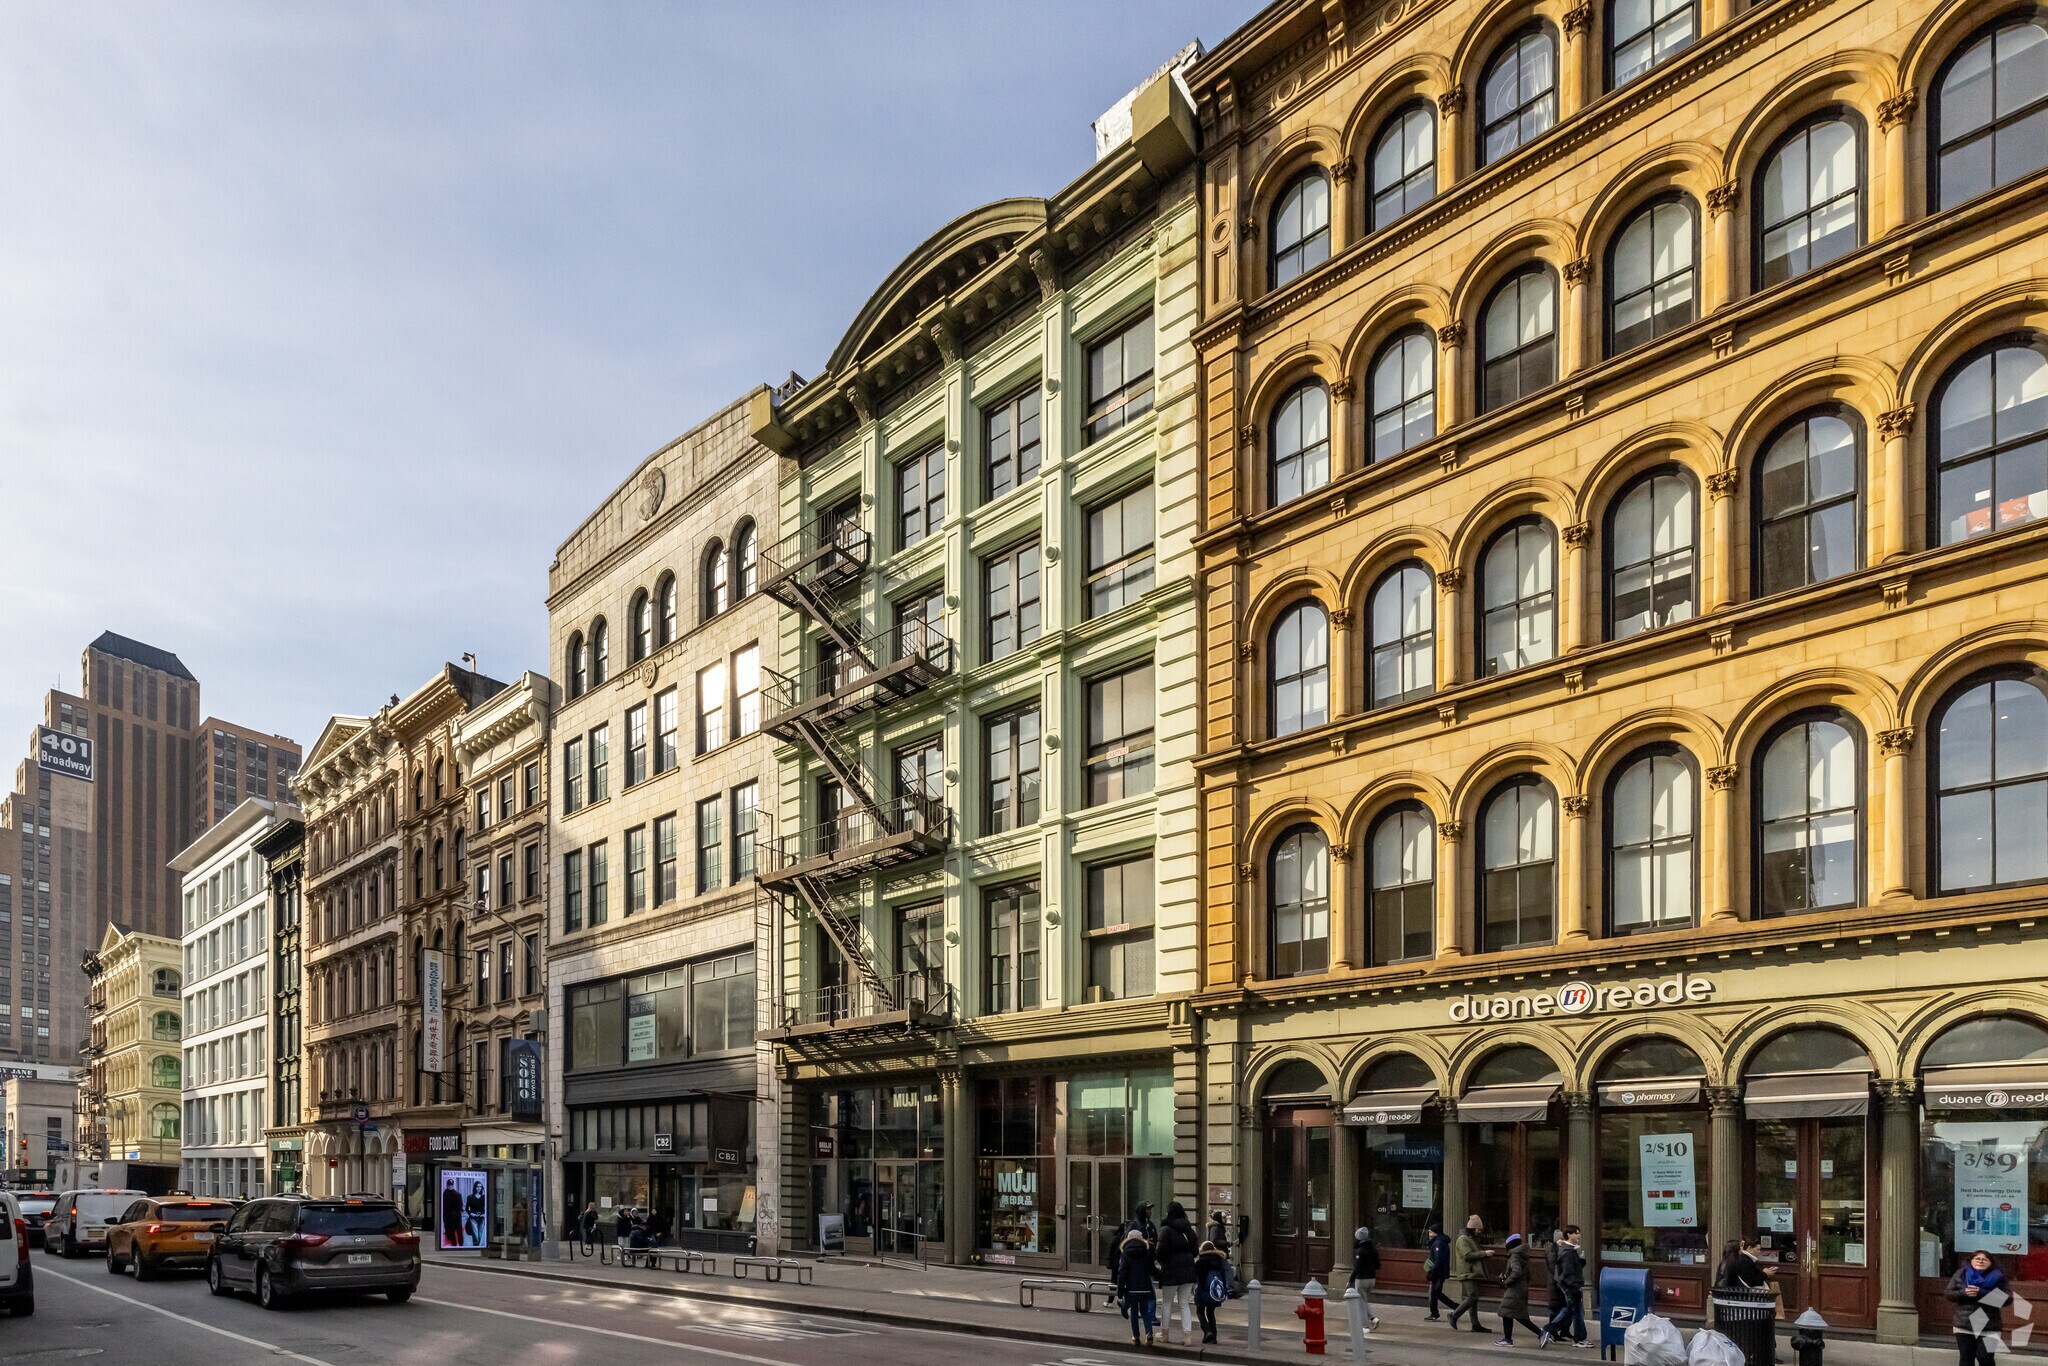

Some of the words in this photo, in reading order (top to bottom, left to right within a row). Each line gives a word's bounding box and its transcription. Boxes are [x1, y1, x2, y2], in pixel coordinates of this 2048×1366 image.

[41, 734, 88, 758] 401
[41, 750, 91, 776] Broadway
[1449, 995, 1554, 1022] duane
[1597, 973, 1711, 1009] reade
[893, 1092, 917, 1108] MUJI
[1636, 1093, 1676, 1102] pharmacy
[1939, 1094, 1983, 1104] duane
[1351, 1114, 1375, 1122] duane
[1388, 1113, 1412, 1121] reade
[429, 1136, 442, 1151] FOOD
[443, 1136, 459, 1151] COURT
[656, 1138, 670, 1147] CB2
[1645, 1141, 1688, 1157] 2/$10
[718, 1152, 736, 1161] CB2
[1384, 1146, 1429, 1158] pharmacy
[1963, 1151, 2018, 1174] 3/$9
[998, 1172, 1037, 1193] MUJI
[1001, 1194, 1033, 1206] 無印良品
